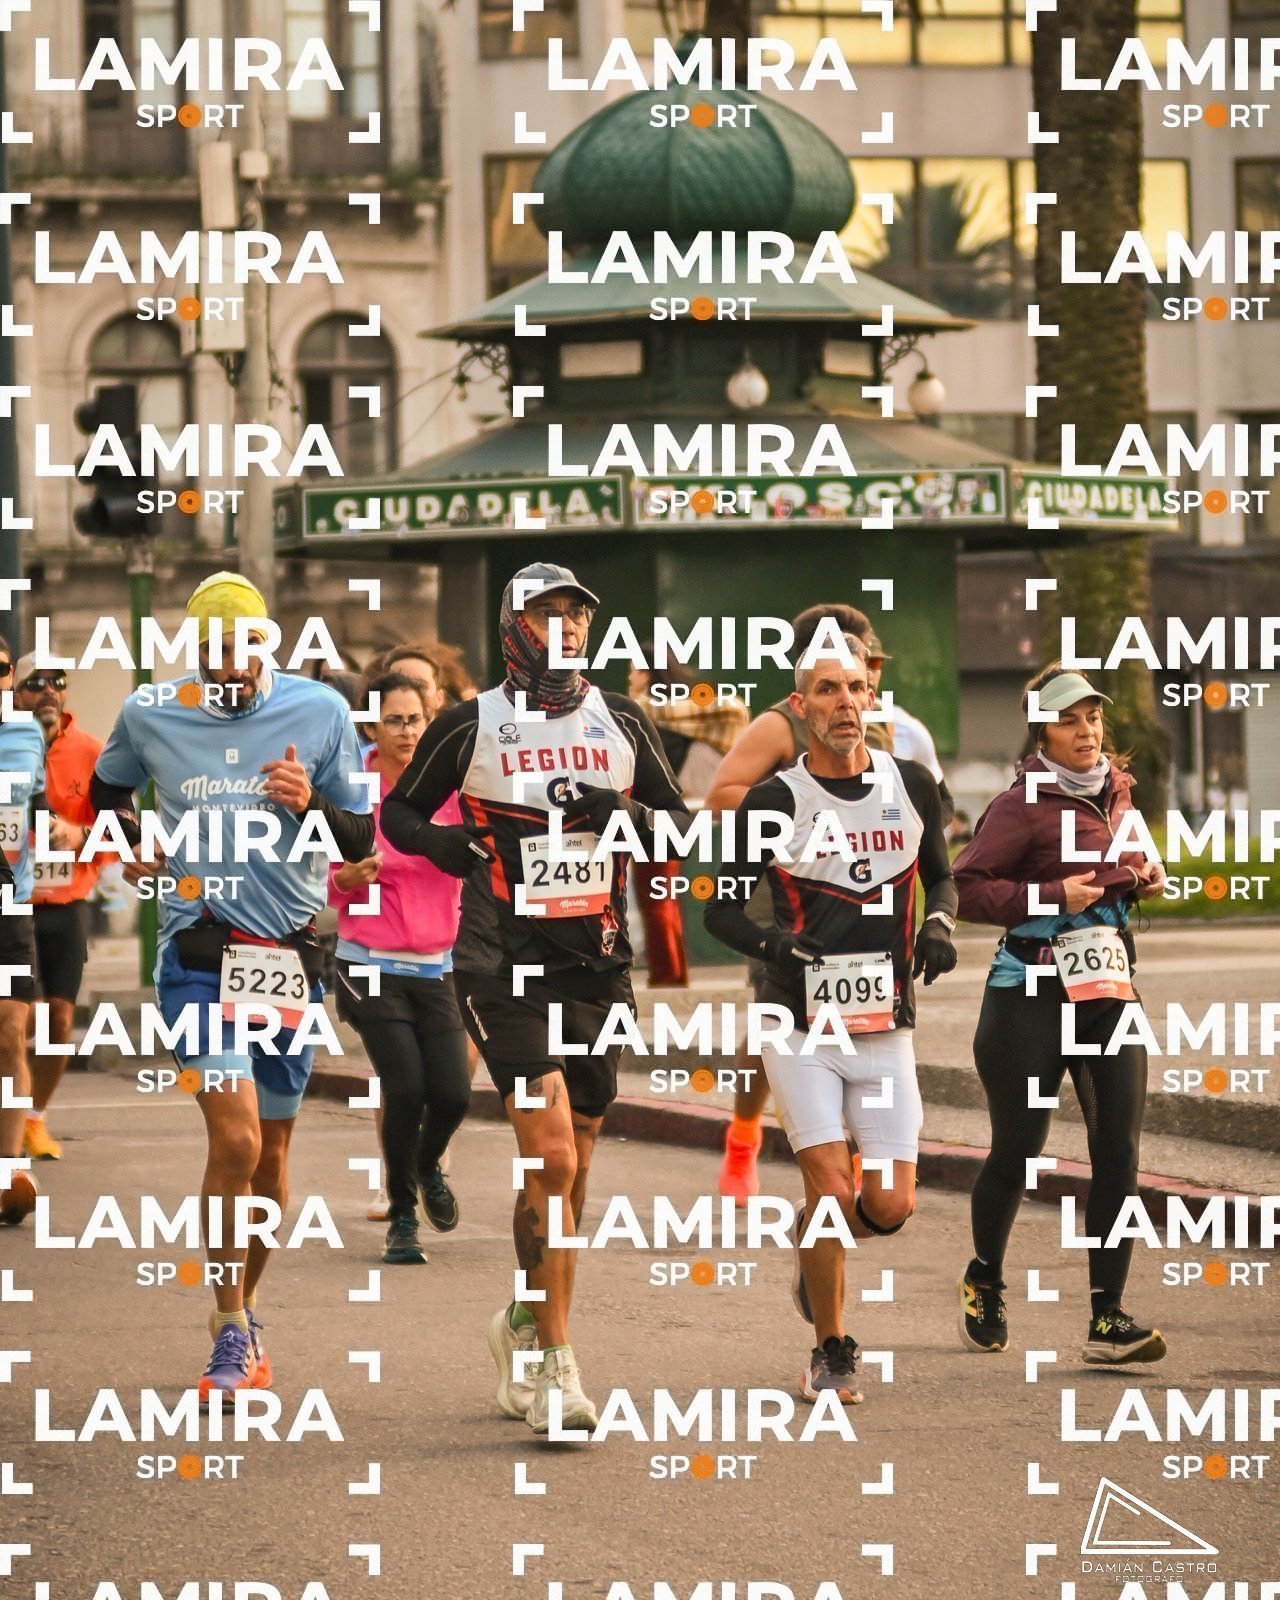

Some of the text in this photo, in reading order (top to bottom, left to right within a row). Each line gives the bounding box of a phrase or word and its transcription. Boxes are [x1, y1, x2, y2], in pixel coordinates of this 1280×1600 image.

[500, 746, 609, 777] LEGION
[180, 774, 281, 801] Marat
[816, 829, 904, 860] GION
[530, 859, 605, 888] 2481
[848, 857, 873, 884] G
[1063, 946, 1126, 977] 2625
[227, 967, 305, 1000] 5223
[813, 976, 887, 1005] 4099
